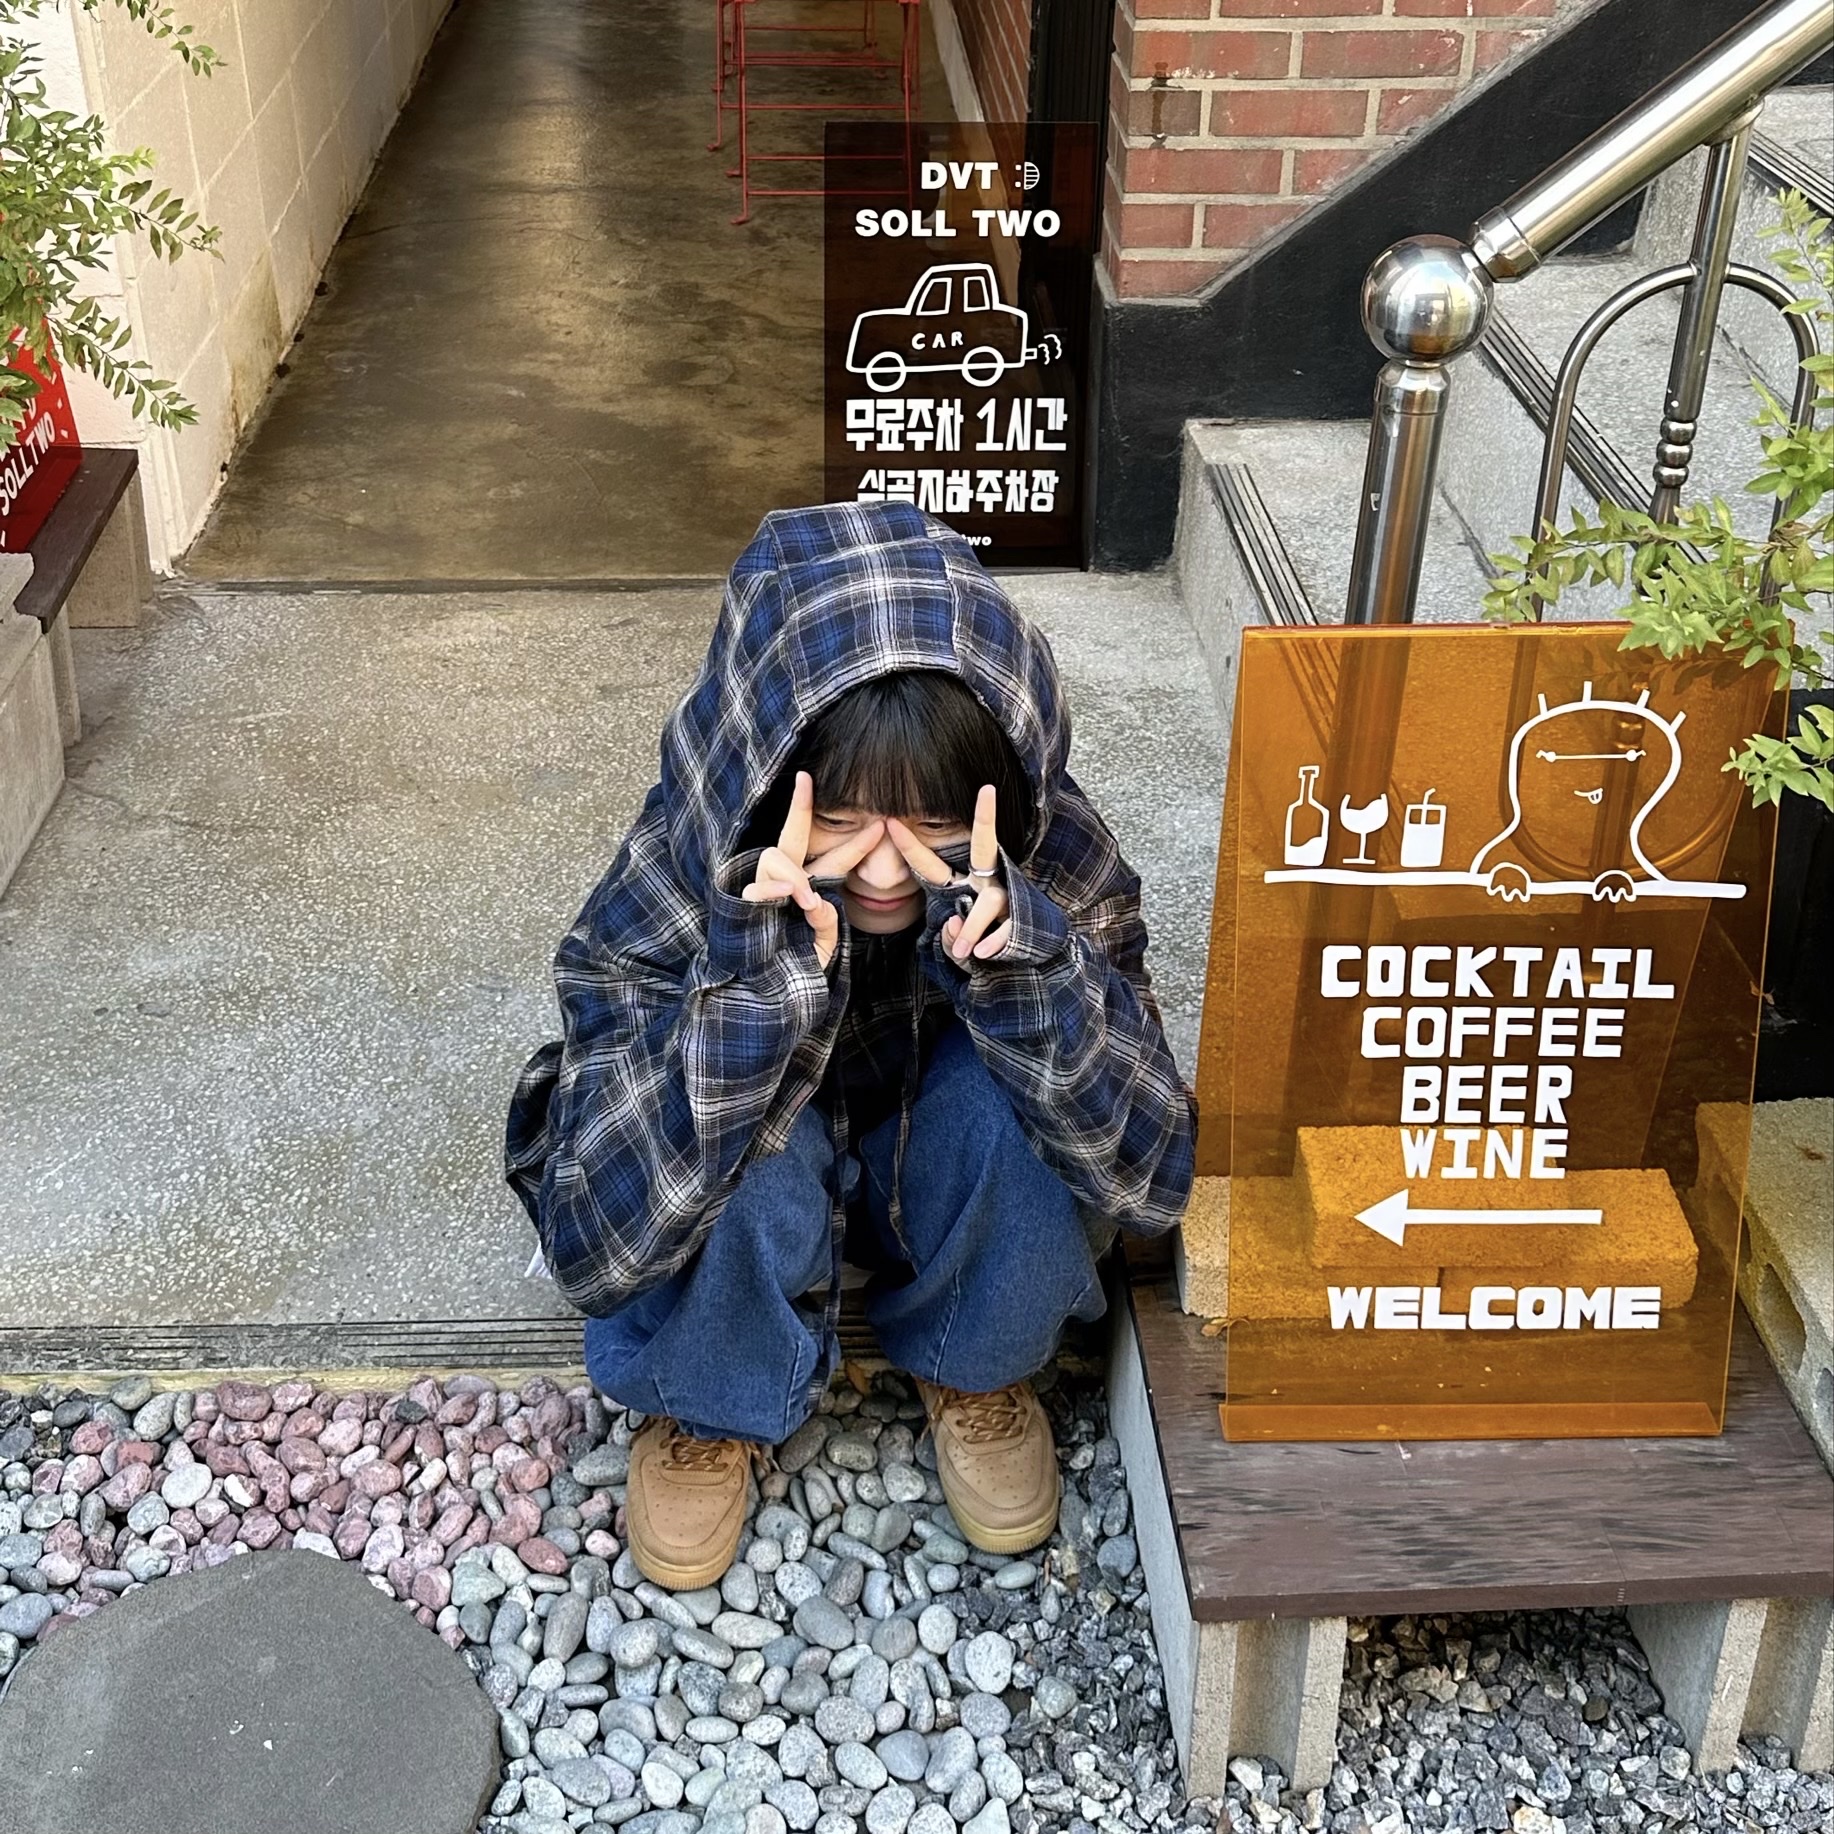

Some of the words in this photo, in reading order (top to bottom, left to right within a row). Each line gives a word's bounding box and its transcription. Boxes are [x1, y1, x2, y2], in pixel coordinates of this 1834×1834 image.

[921, 161, 999, 190] DVT
[855, 208, 957, 237] SOLL
[971, 209, 1061, 237] TWO
[911, 331, 964, 350] CAR
[846, 398, 964, 451] 무료주차
[975, 397, 1068, 451] 1시간
[1320, 945, 1675, 999] COCKTAIL
[1360, 1006, 1624, 1059] COFFEE
[1400, 1064, 1573, 1124] BEER
[1400, 1128, 1568, 1179] WINE
[1327, 1286, 1661, 1331] WELCOME
